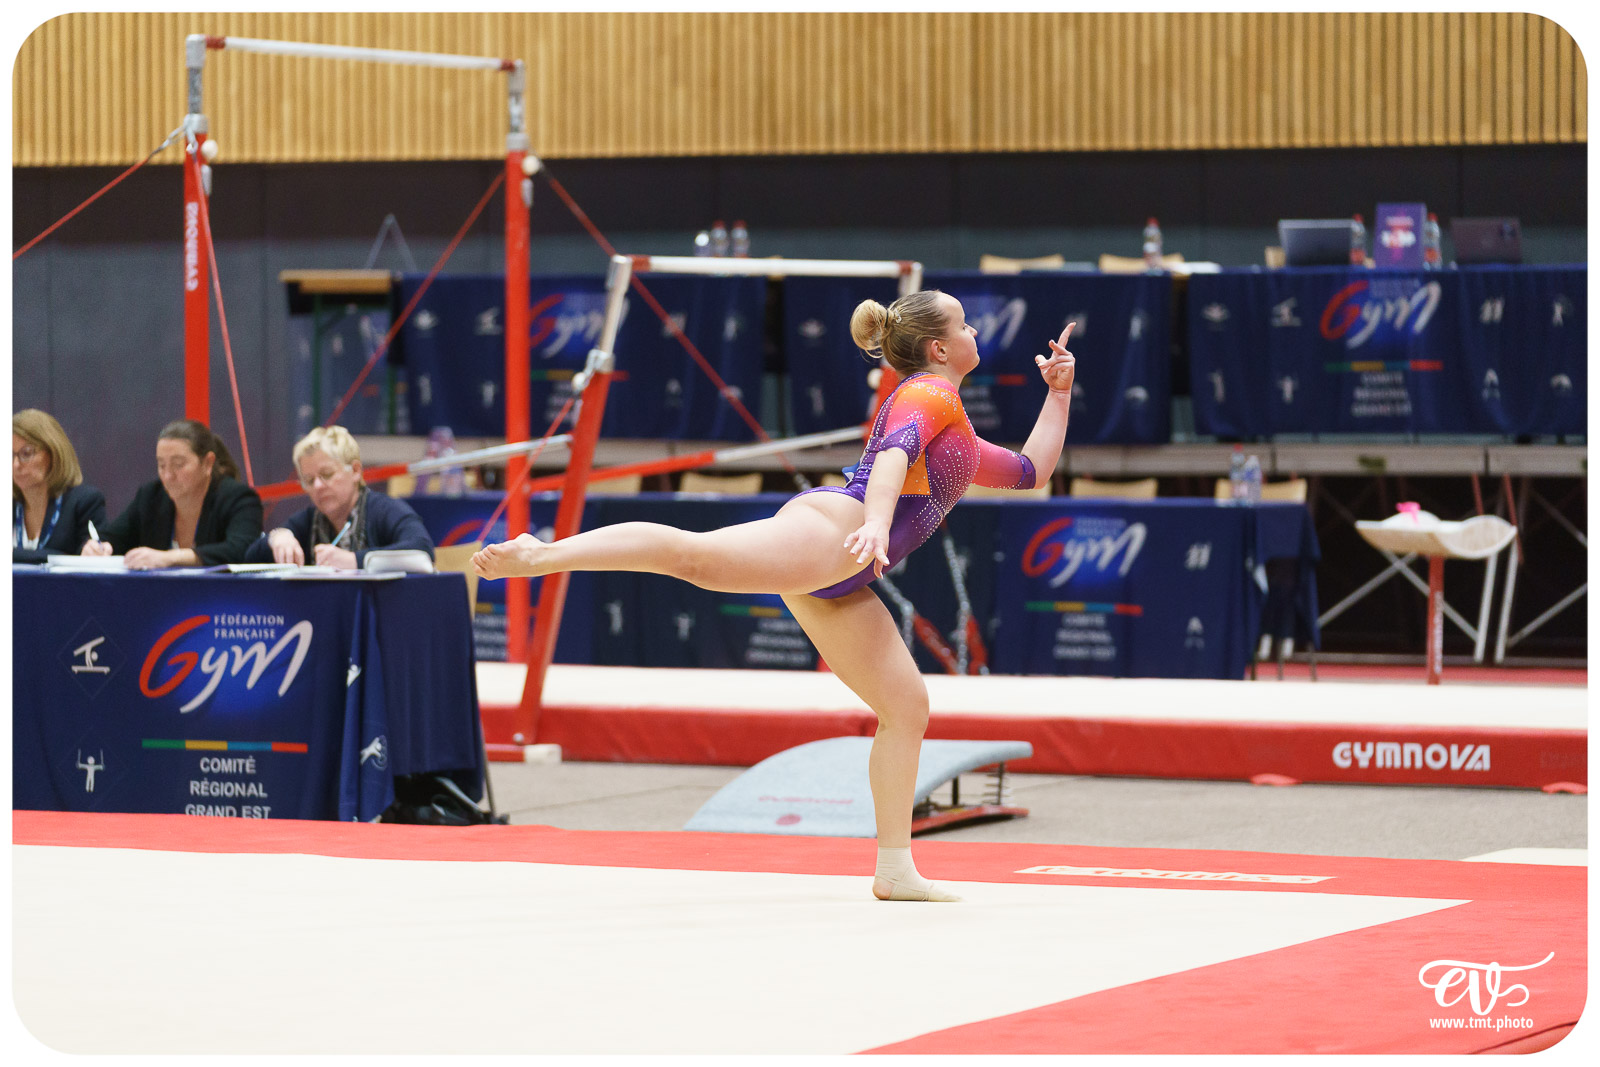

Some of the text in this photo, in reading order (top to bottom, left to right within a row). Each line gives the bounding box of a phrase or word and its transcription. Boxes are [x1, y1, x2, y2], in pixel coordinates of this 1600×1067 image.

[214, 613, 284, 625] FÉDÉRATION
[214, 628, 275, 641] FRANÇAISE
[200, 755, 256, 774] COMITÉ
[1332, 742, 1491, 771] GYMNOVA
[189, 777, 268, 798] RÉGIONAL
[185, 803, 271, 819] GRAND EST
